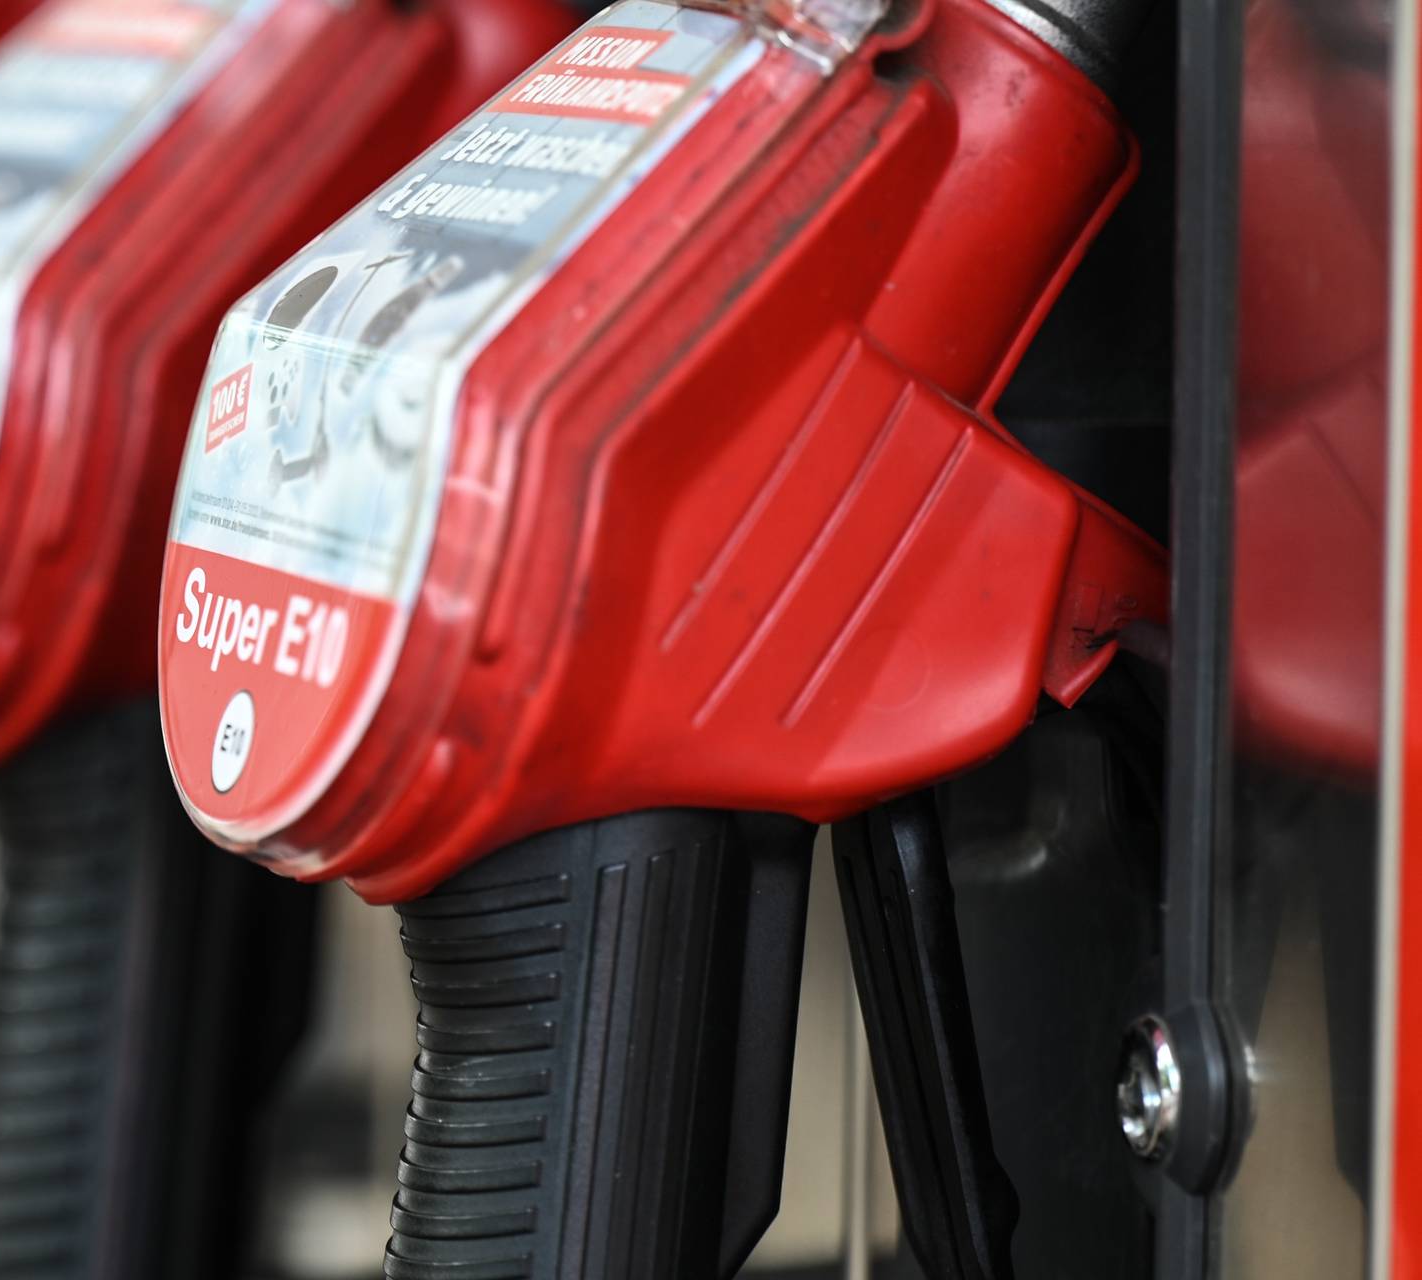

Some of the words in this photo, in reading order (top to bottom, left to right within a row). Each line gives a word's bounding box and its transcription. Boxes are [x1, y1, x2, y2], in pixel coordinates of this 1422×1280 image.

[556, 36, 658, 70] MISSION
[440, 123, 530, 165] Jetzt
[377, 173, 427, 213] &
[212, 380, 237, 424] 100
[237, 371, 250, 408] €
[176, 567, 279, 672] Super
[274, 595, 349, 688] E10
[220, 723, 246, 756] E10
